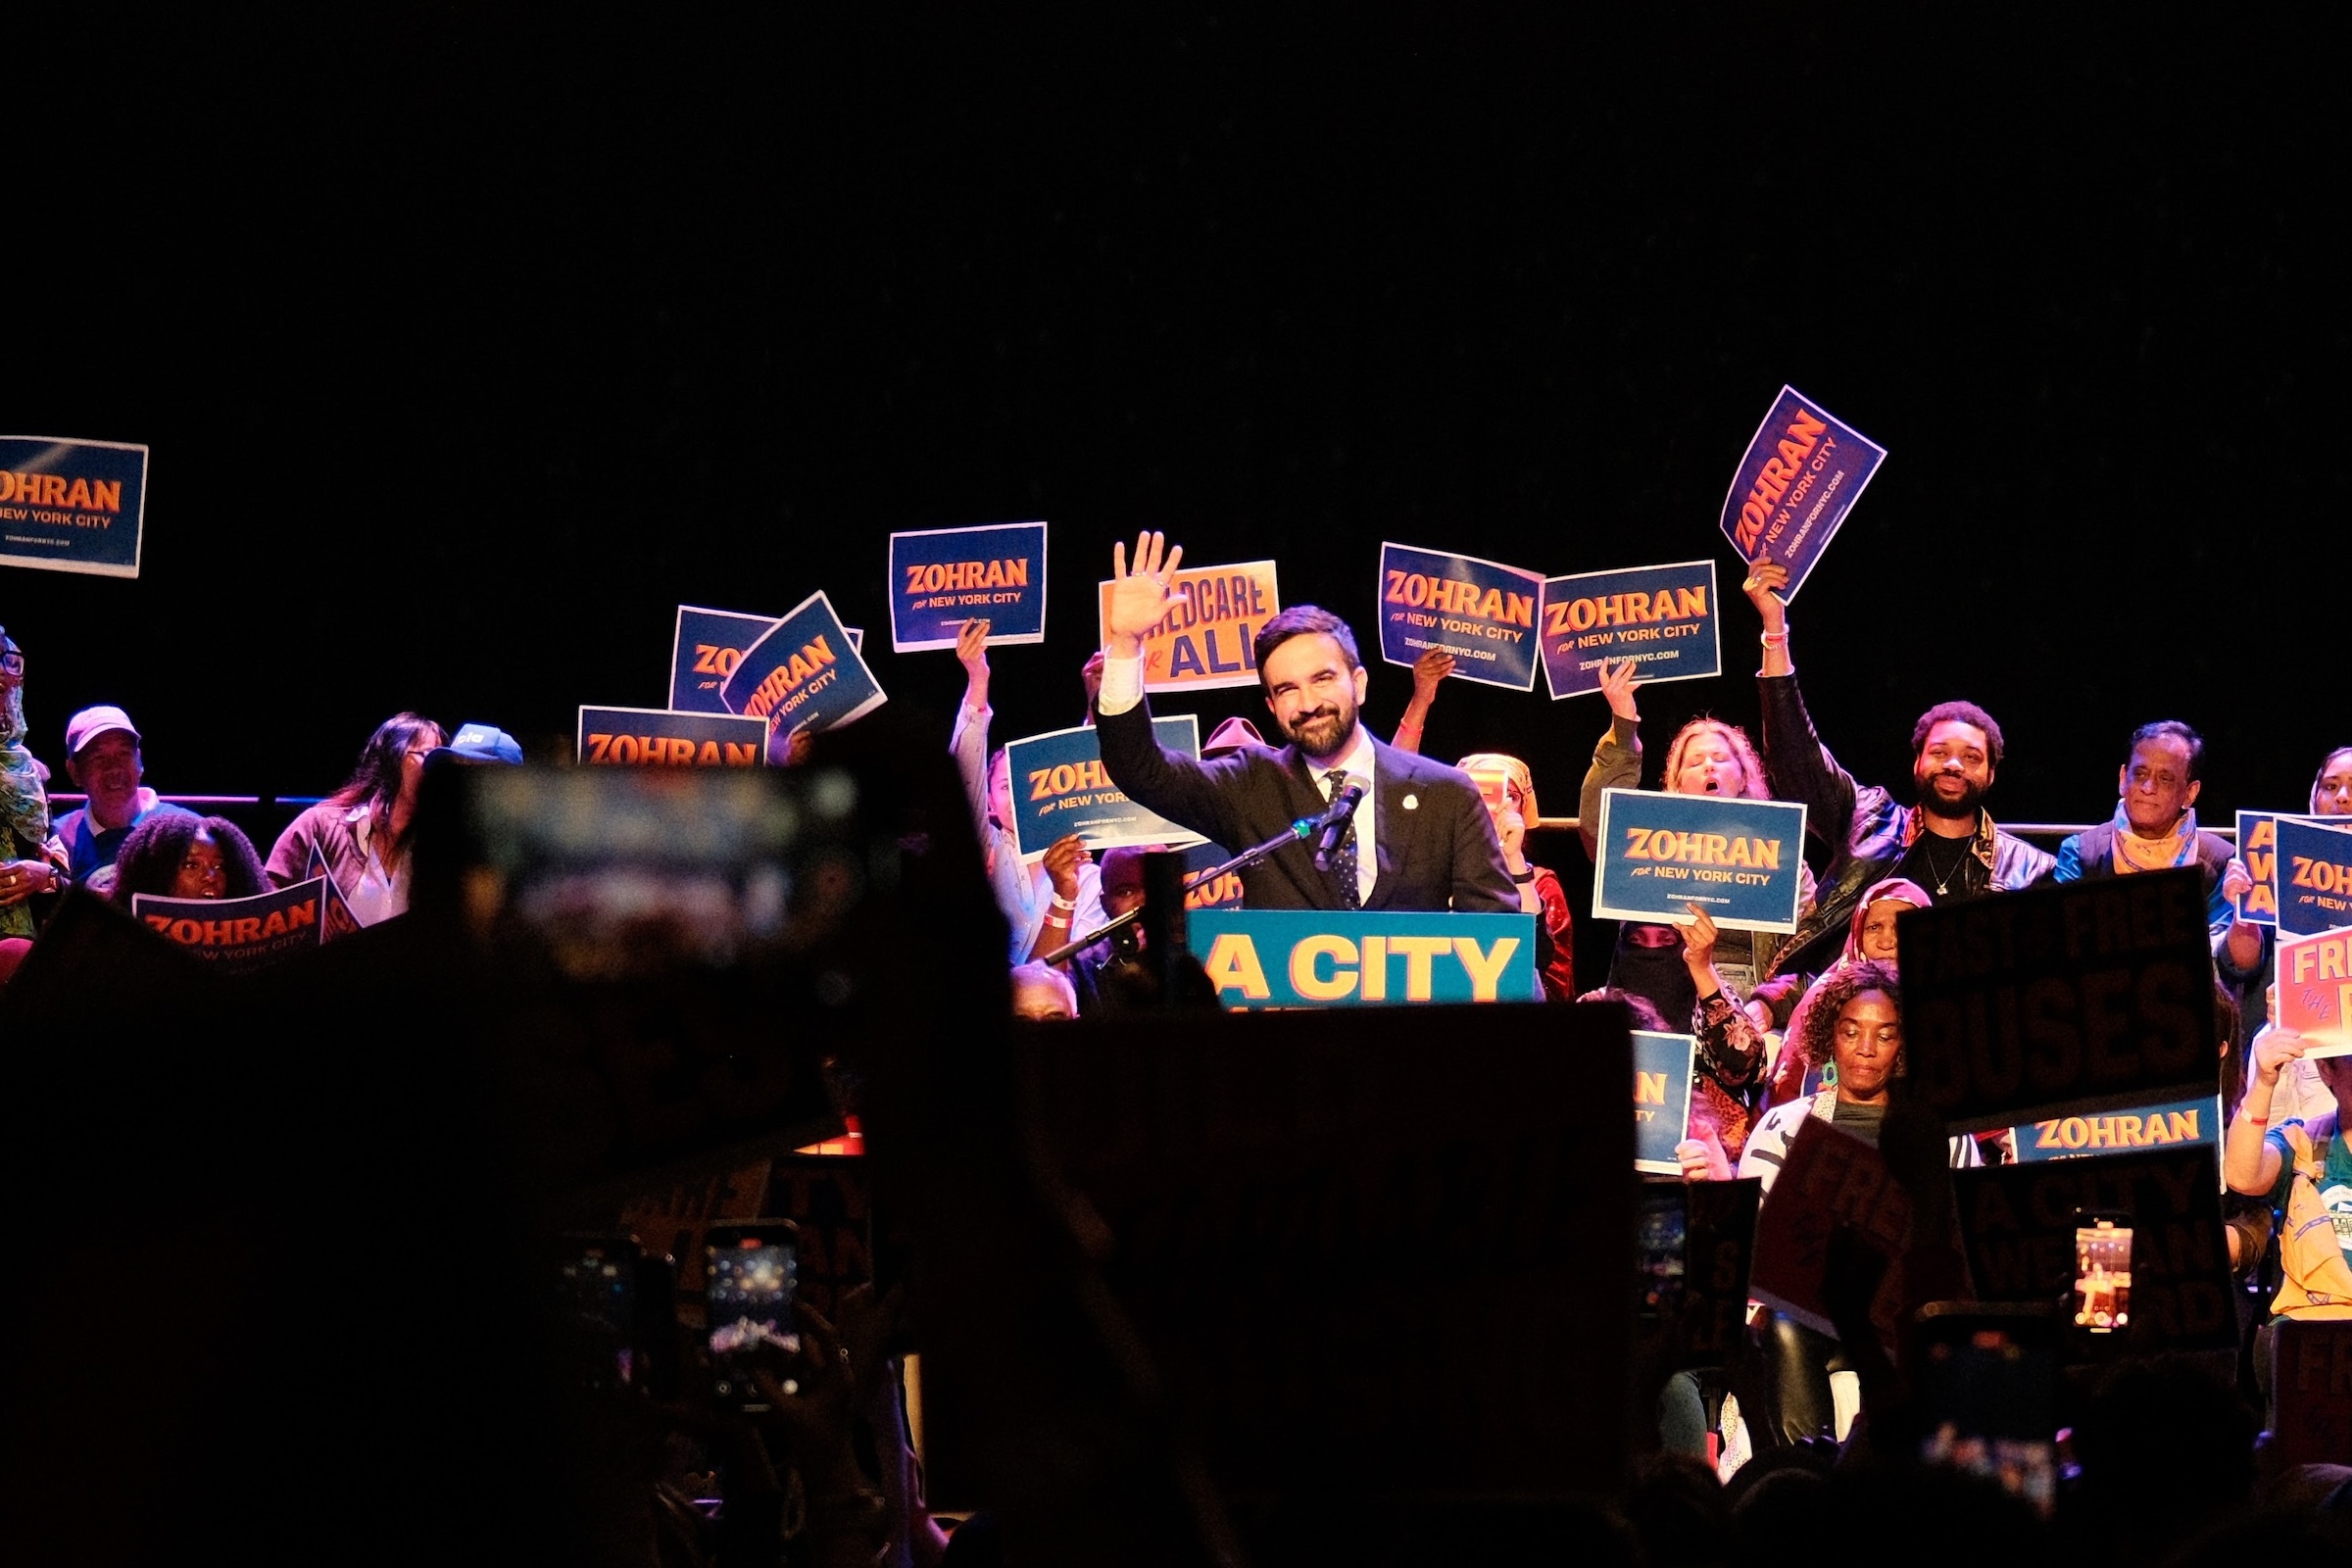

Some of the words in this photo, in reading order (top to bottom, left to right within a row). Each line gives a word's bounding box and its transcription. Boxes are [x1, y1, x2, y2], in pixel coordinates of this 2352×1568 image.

[1735, 408, 1827, 557] ZOHRAN
[1765, 509, 1790, 544] NEW
[1786, 469, 1818, 509] YORK
[1811, 436, 1838, 471] CITY
[31, 510, 73, 526] YORK
[75, 514, 112, 529] CITY
[1784, 469, 1845, 559] ZOHRANFORNYC.COM
[906, 558, 1029, 595] ZOHRAN
[1385, 569, 1535, 628] ZOHRAN
[929, 596, 956, 608] NEW
[958, 593, 992, 606] YORK
[993, 591, 1022, 604] CITY
[1146, 575, 1266, 640] LDCARE
[1544, 585, 1708, 637] ZOHRAN
[1170, 622, 1257, 677] ALL
[1406, 612, 1438, 628] NEW
[1441, 617, 1483, 637] YORK
[1486, 625, 1524, 644] CITY
[1556, 640, 1574, 656] FOR
[1578, 632, 1613, 649] NEW
[1617, 627, 1661, 643] YORK
[1663, 623, 1700, 638] CITY
[779, 689, 809, 716] YORK
[808, 668, 837, 694] CITY
[588, 733, 758, 766] ZOHRAN
[1039, 803, 1055, 816] FOR
[1058, 794, 1092, 809] NEW
[1095, 791, 1130, 805] YOR
[1624, 827, 1782, 870] ZOHRAN
[1630, 866, 1651, 877] FOR
[1654, 865, 1690, 880] NEW
[1692, 869, 1733, 883] YORK
[1736, 872, 1771, 886] CITY
[143, 898, 318, 946] ZOHRAN
[2062, 880, 2193, 959] FREE
[2317, 896, 2347, 911] NEW
[1204, 934, 1271, 1000] A
[1288, 934, 1521, 1004] CITY
[2303, 988, 2332, 1020] THE
[1919, 960, 2201, 1110] BUSES
[2034, 1108, 2200, 1150] ZOHRAN
